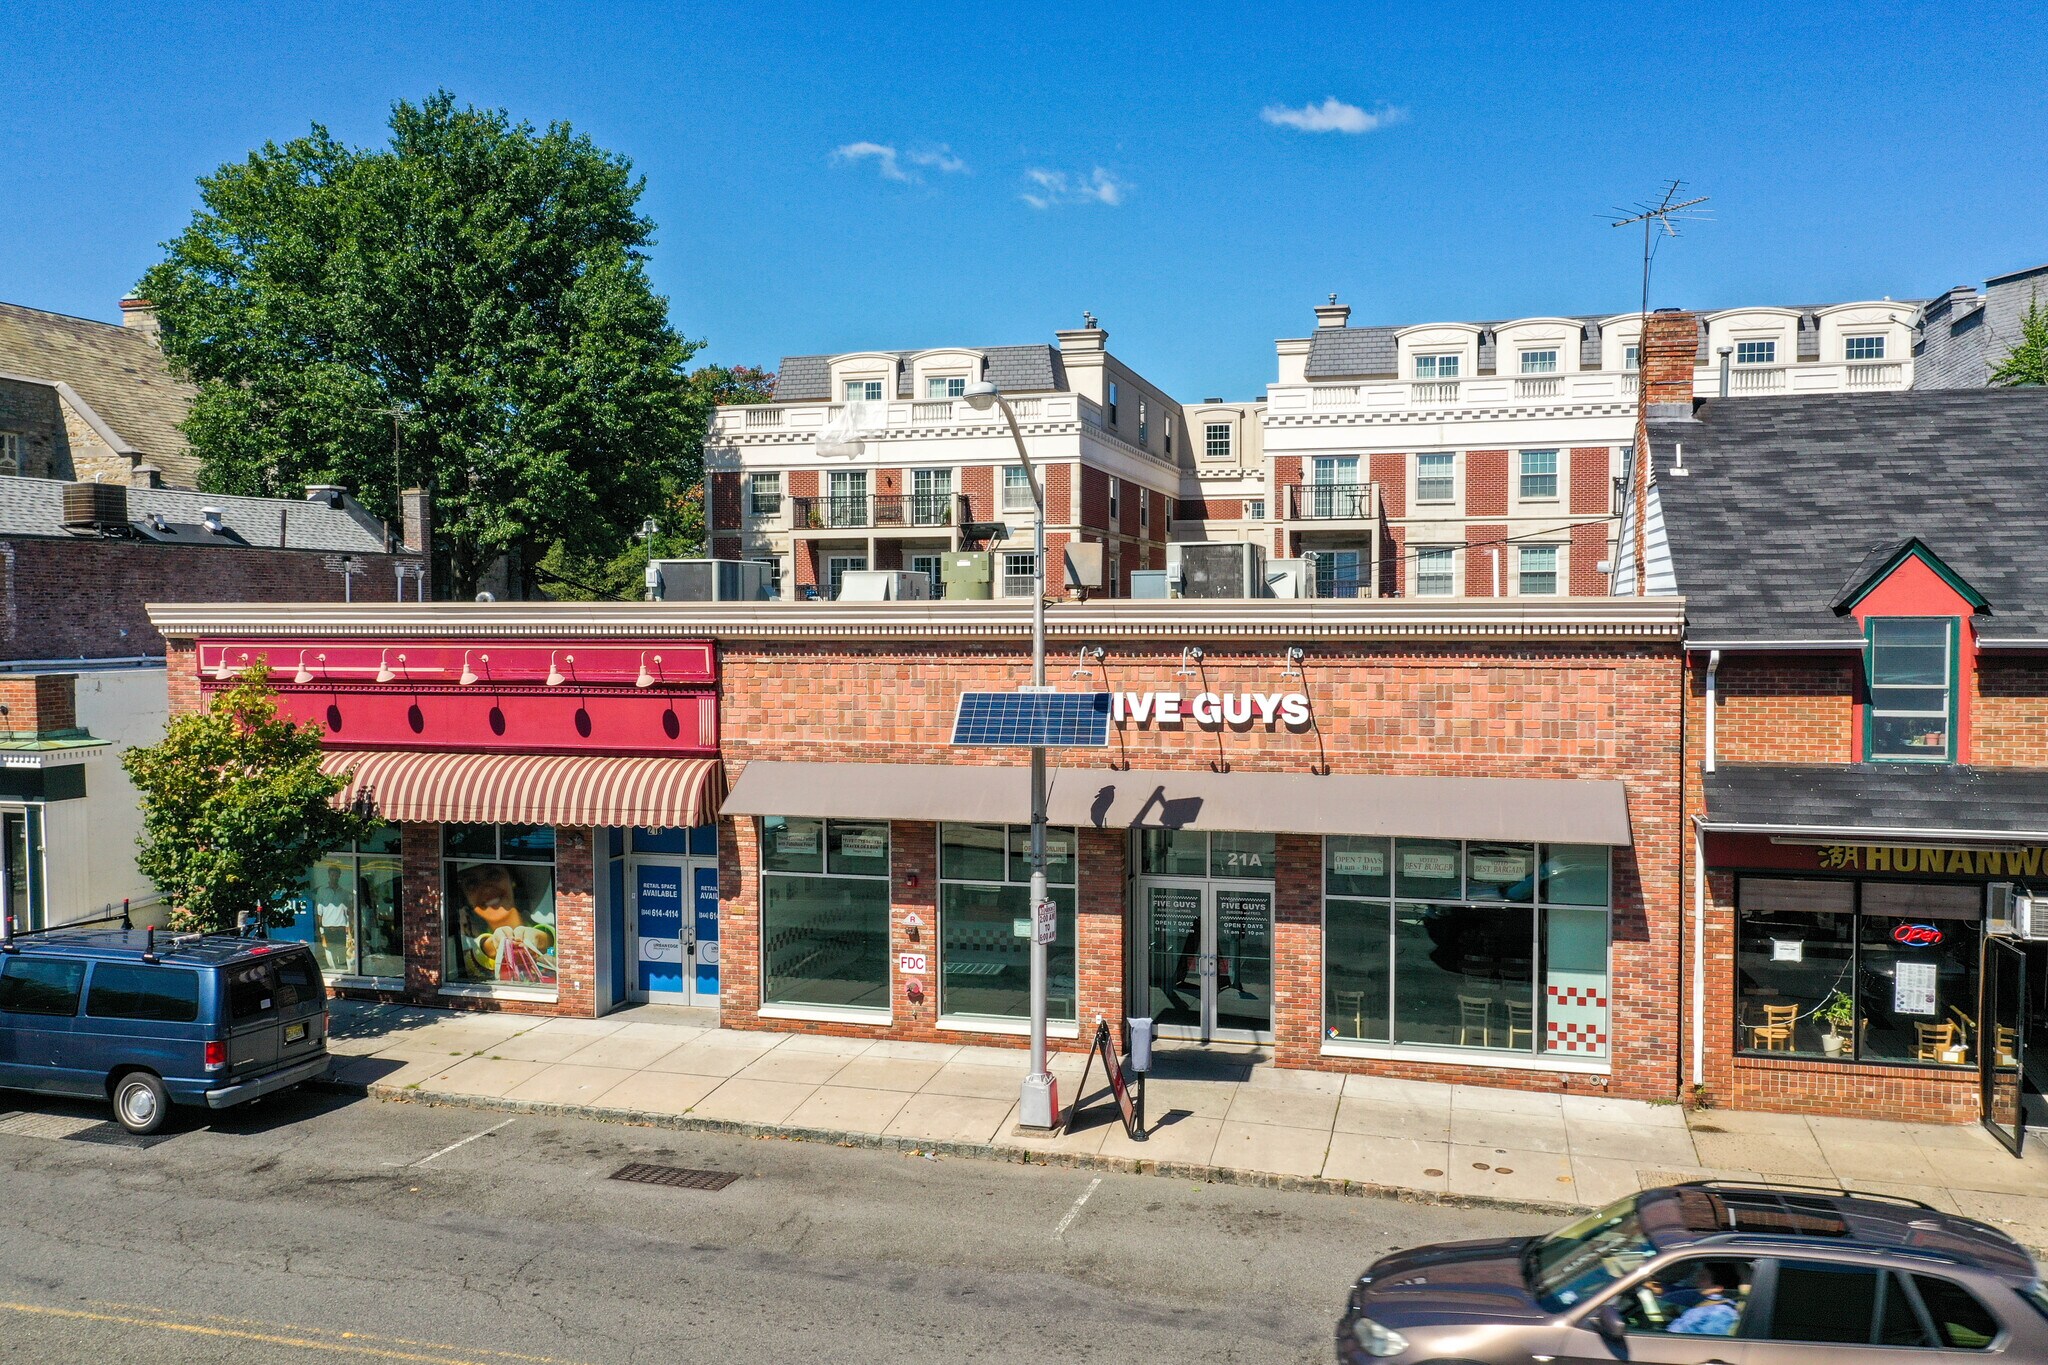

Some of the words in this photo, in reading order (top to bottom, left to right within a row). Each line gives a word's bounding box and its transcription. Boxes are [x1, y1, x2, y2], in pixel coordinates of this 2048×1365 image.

[1113, 692, 1180, 722] IVE
[1192, 692, 1309, 725] GUYS
[1227, 853, 1262, 867] 21A
[1405, 862, 1423, 870] BEST
[1424, 862, 1454, 871] BURGER
[642, 889, 678, 898] AVAILABLE
[700, 892, 718, 900] AVAIL
[1152, 900, 1171, 908] FIVE
[1172, 900, 1197, 909] GUYS
[1221, 902, 1240, 910] FIVE
[1242, 902, 1266, 911] GUYS
[1894, 925, 1943, 943] Open
[901, 956, 924, 970] FDC
